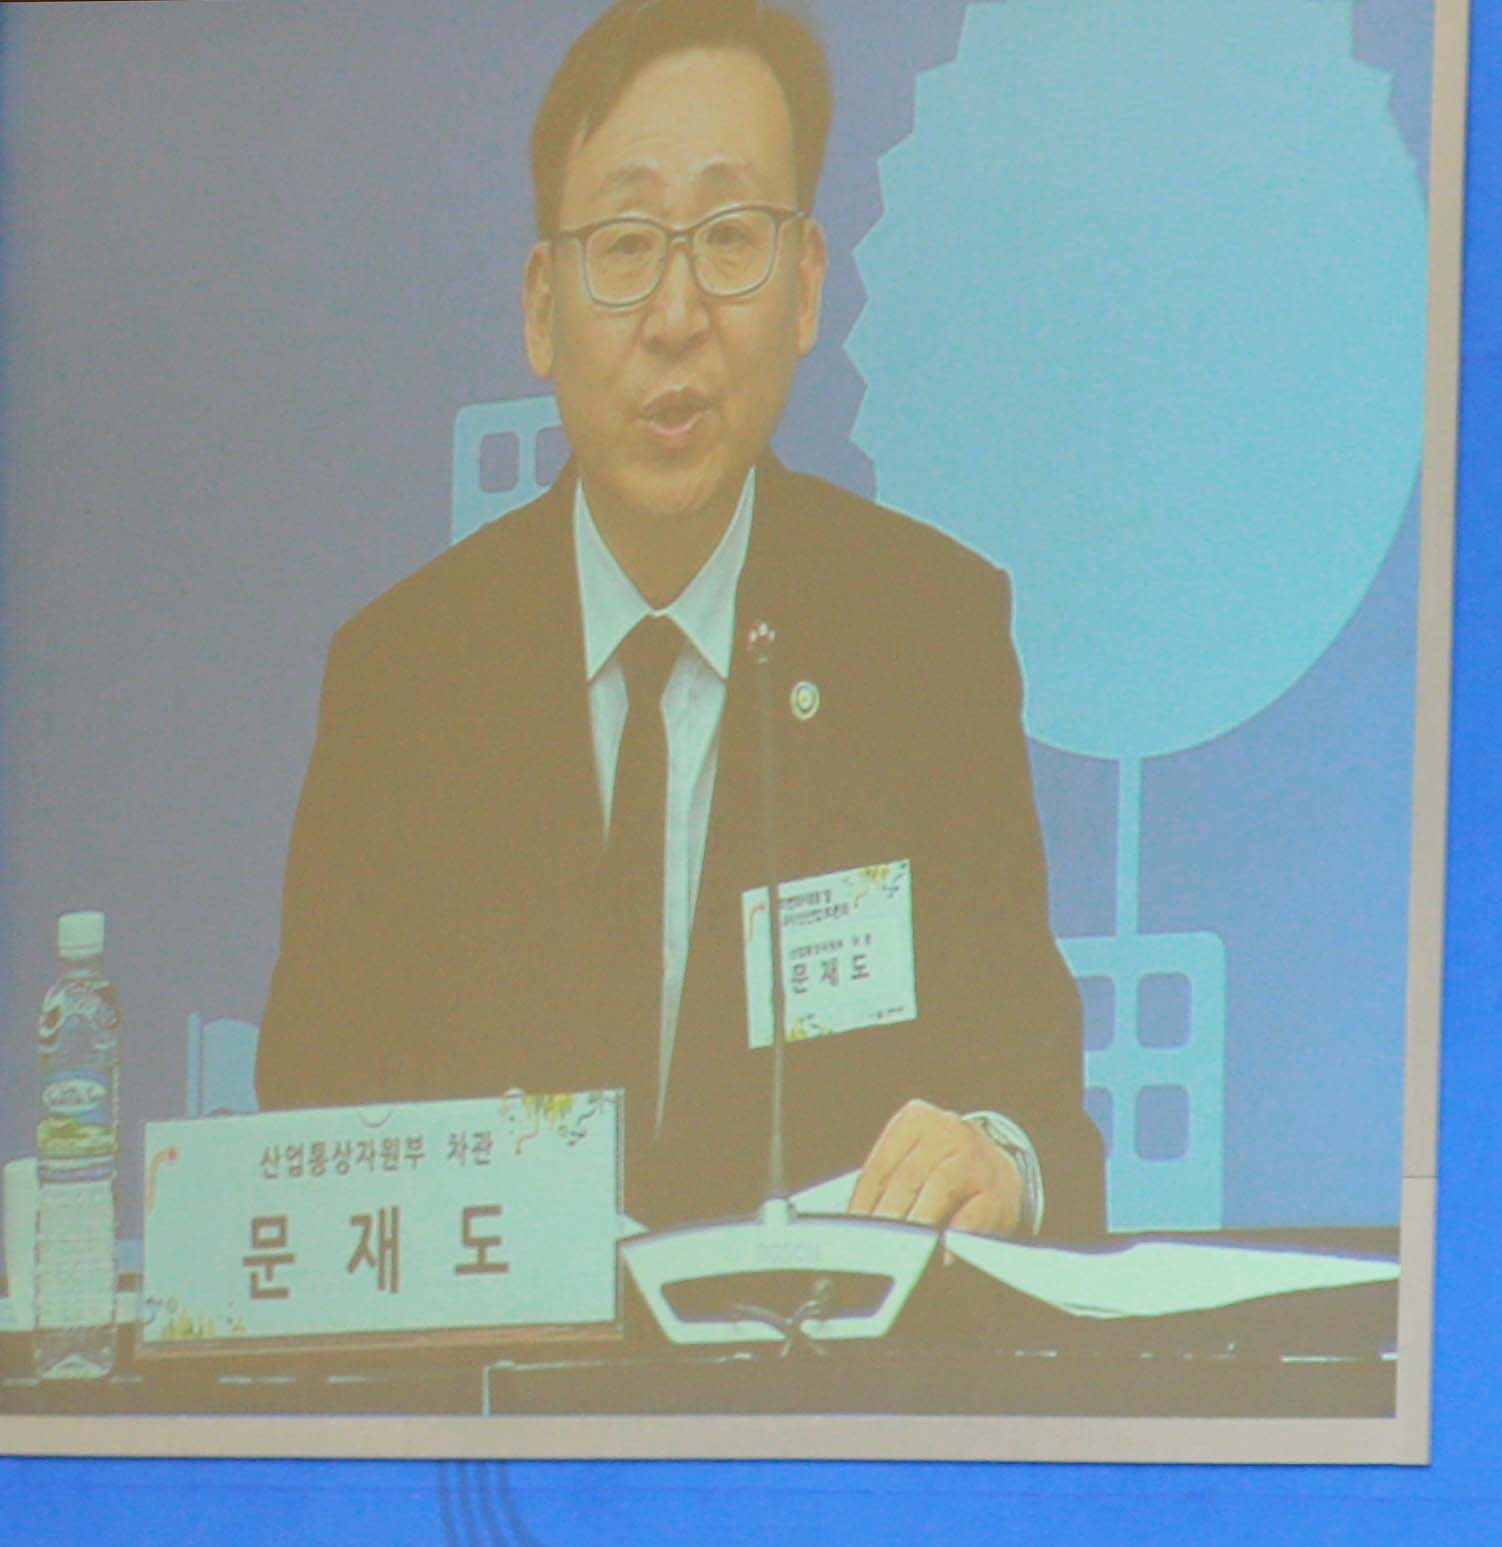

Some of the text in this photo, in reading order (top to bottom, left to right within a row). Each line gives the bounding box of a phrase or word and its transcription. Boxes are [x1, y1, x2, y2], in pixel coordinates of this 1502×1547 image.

[260, 1131, 493, 1180] 산업통상자원부 차관
[242, 1204, 509, 1299] 문 재 도
